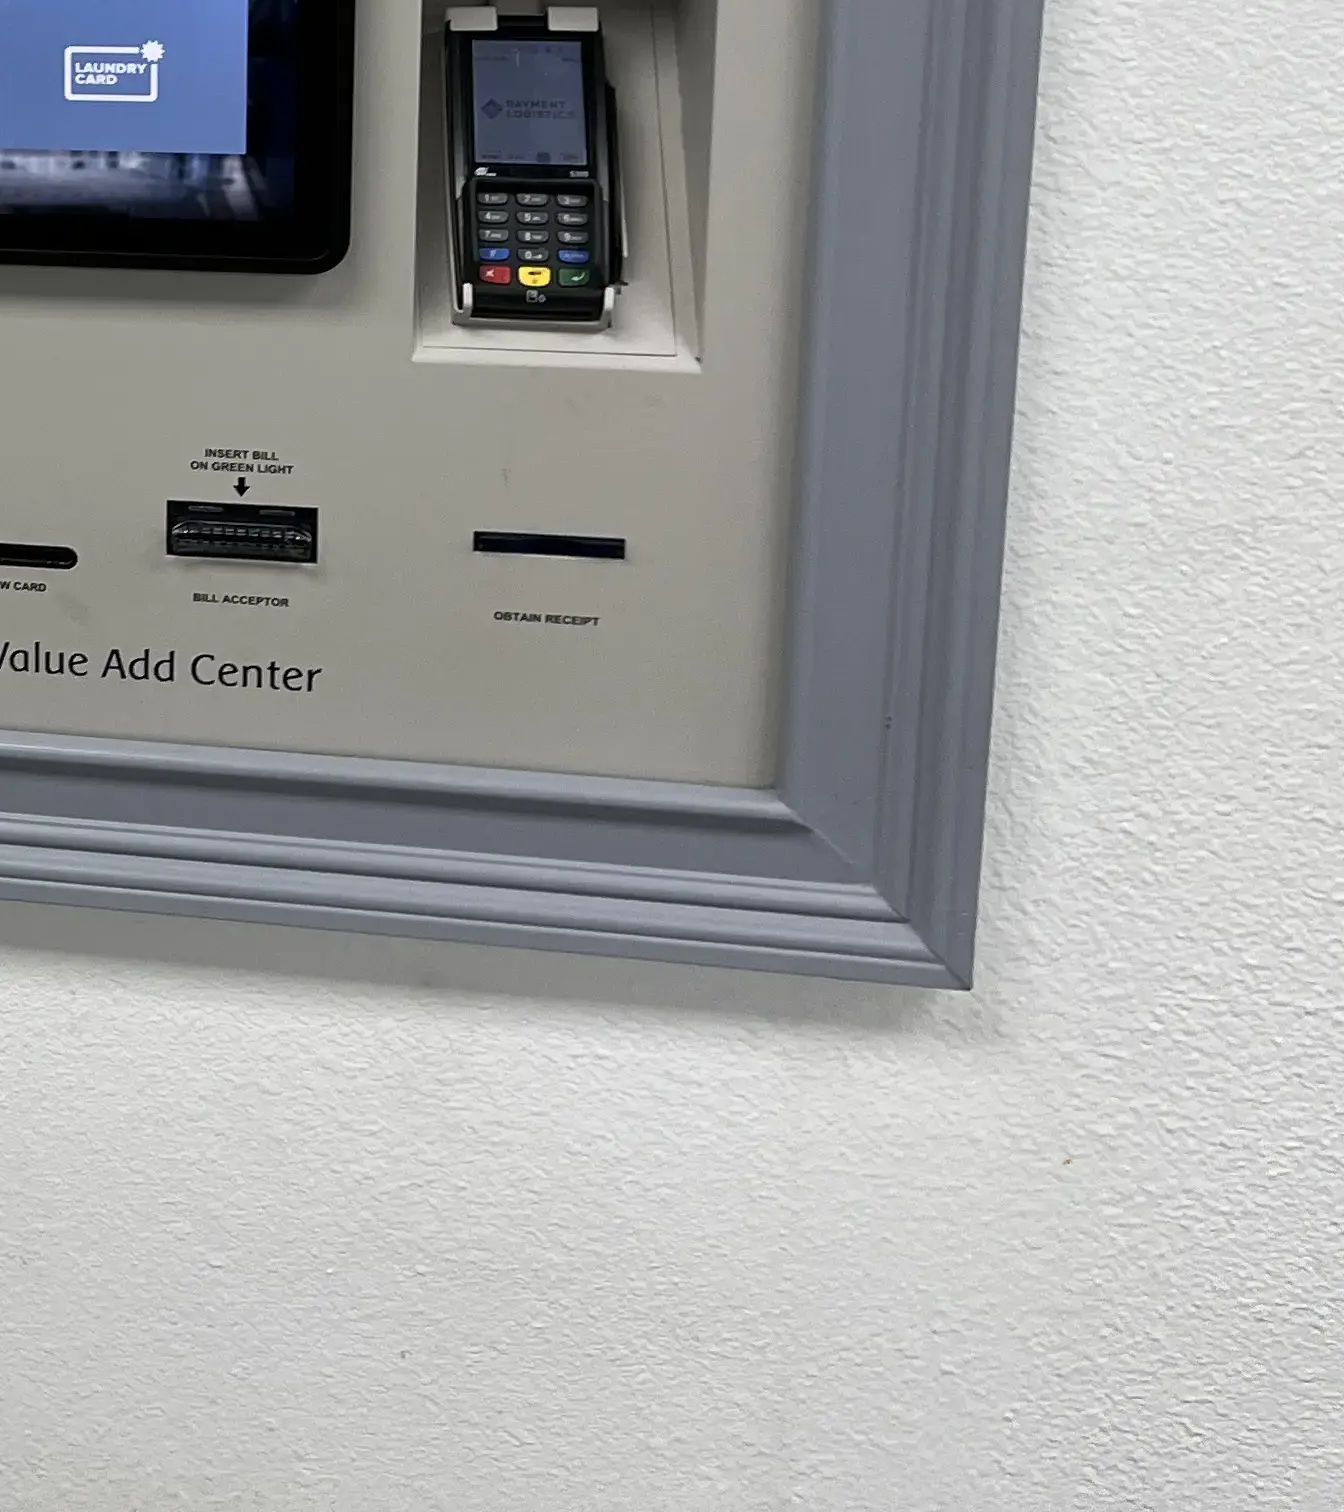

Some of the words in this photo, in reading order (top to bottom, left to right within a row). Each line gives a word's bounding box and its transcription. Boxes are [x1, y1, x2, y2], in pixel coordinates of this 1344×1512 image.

[75, 63, 147, 74] LAUNDRY
[75, 74, 118, 85] CARD
[204, 448, 250, 460] INSERT
[252, 450, 280, 461] BILL
[190, 460, 209, 470] ON
[211, 461, 254, 473] GREEN
[256, 463, 294, 475] LIGHT
[13, 581, 47, 592] CARD
[192, 592, 220, 604] BILL
[222, 594, 290, 608] ACCEPTOR
[494, 611, 542, 622] OBTAIN
[545, 614, 600, 626] RECEIPT
[101, 648, 176, 682] Add
[190, 654, 323, 692] Center
